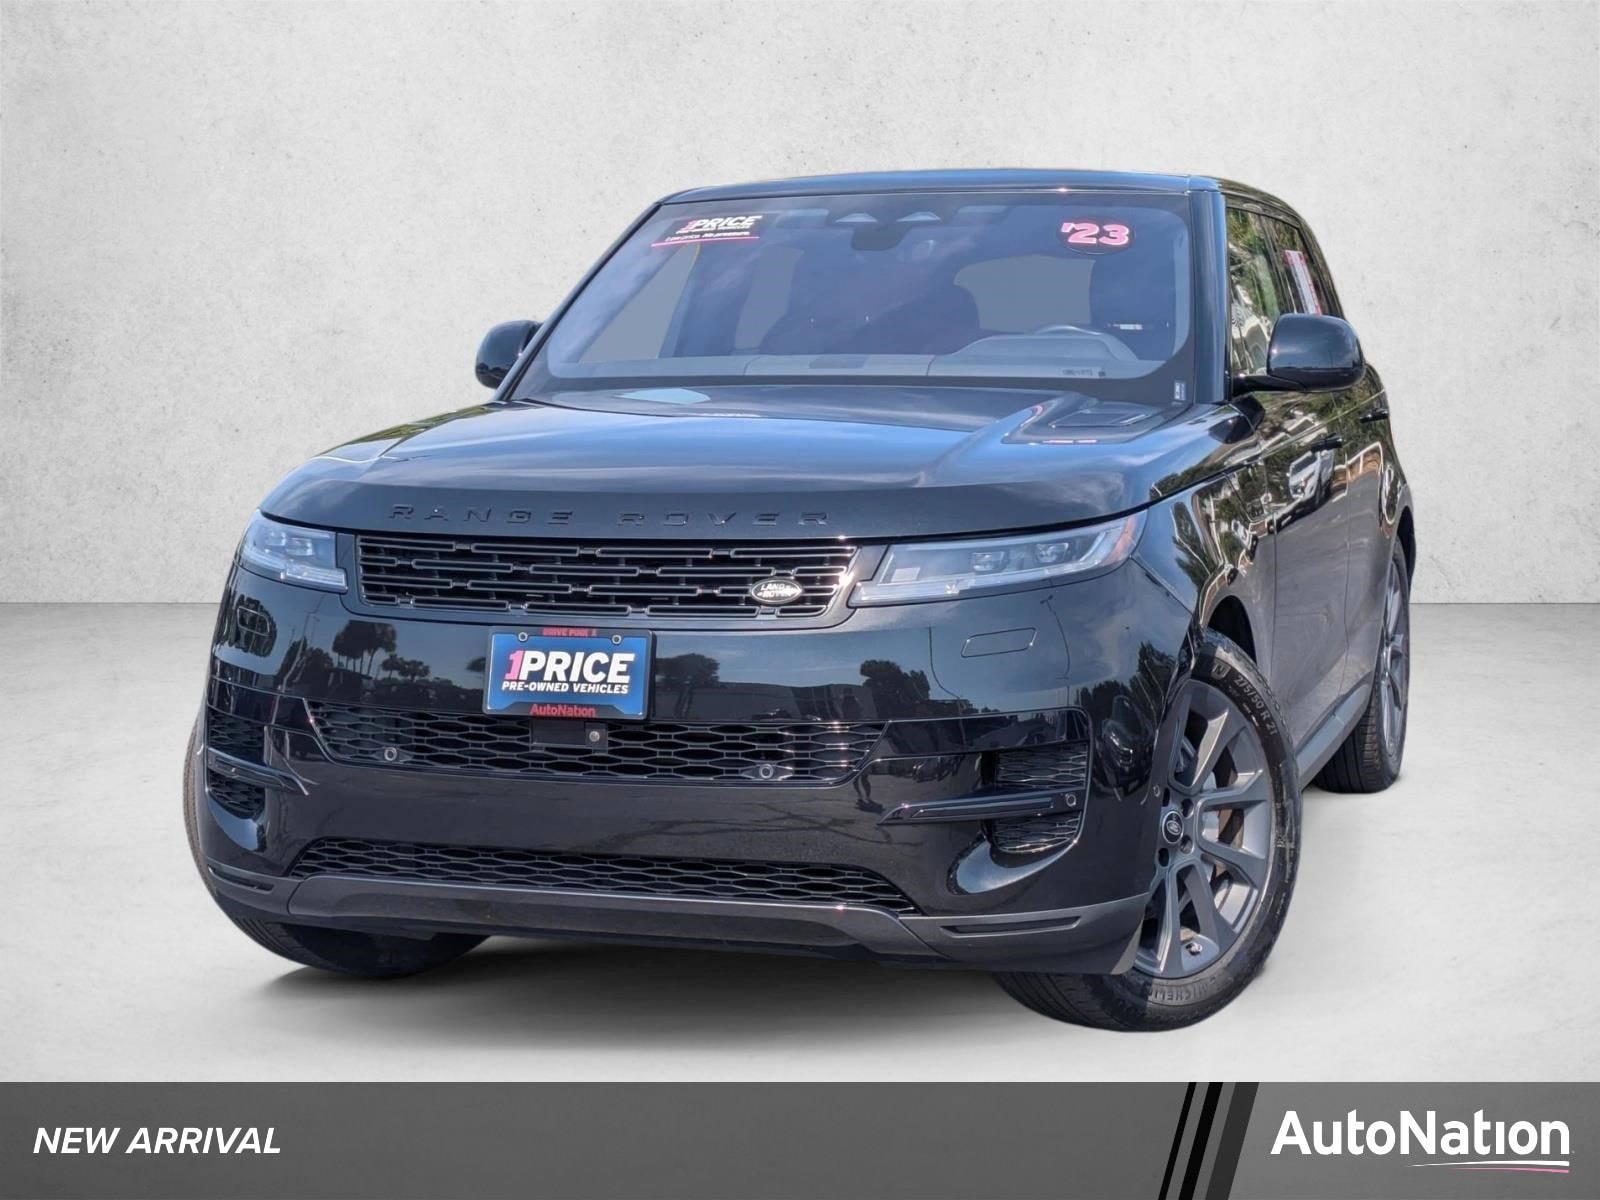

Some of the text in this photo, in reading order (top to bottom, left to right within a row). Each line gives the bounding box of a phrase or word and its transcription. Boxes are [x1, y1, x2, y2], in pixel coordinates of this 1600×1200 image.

[389, 503, 828, 526] RANGE ROVER
[760, 583, 786, 591] LAND
[501, 680, 629, 695] PRE-OWNED VEHICLES
[529, 703, 597, 717] AutoNation
